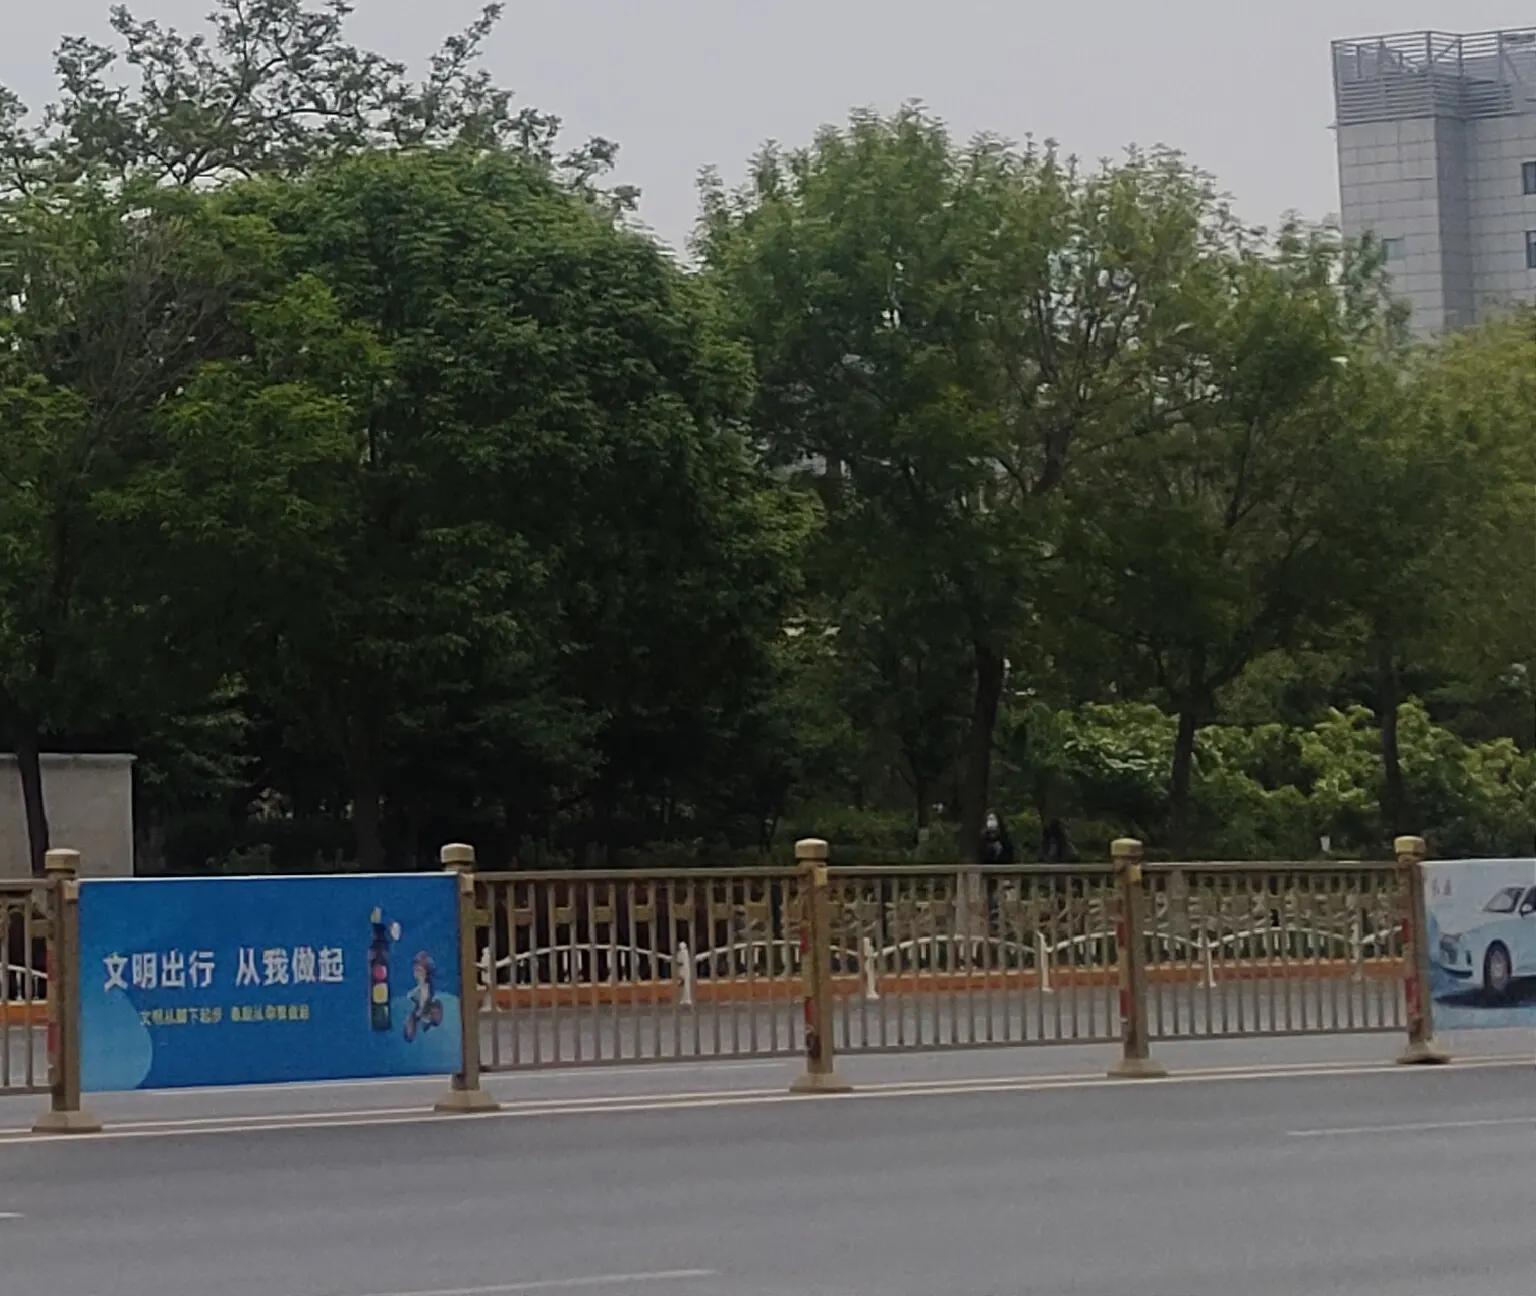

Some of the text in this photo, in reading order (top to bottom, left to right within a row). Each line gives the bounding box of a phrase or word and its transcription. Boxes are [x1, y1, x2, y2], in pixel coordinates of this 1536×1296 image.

[103, 947, 344, 992] 文明出行 从我做起
